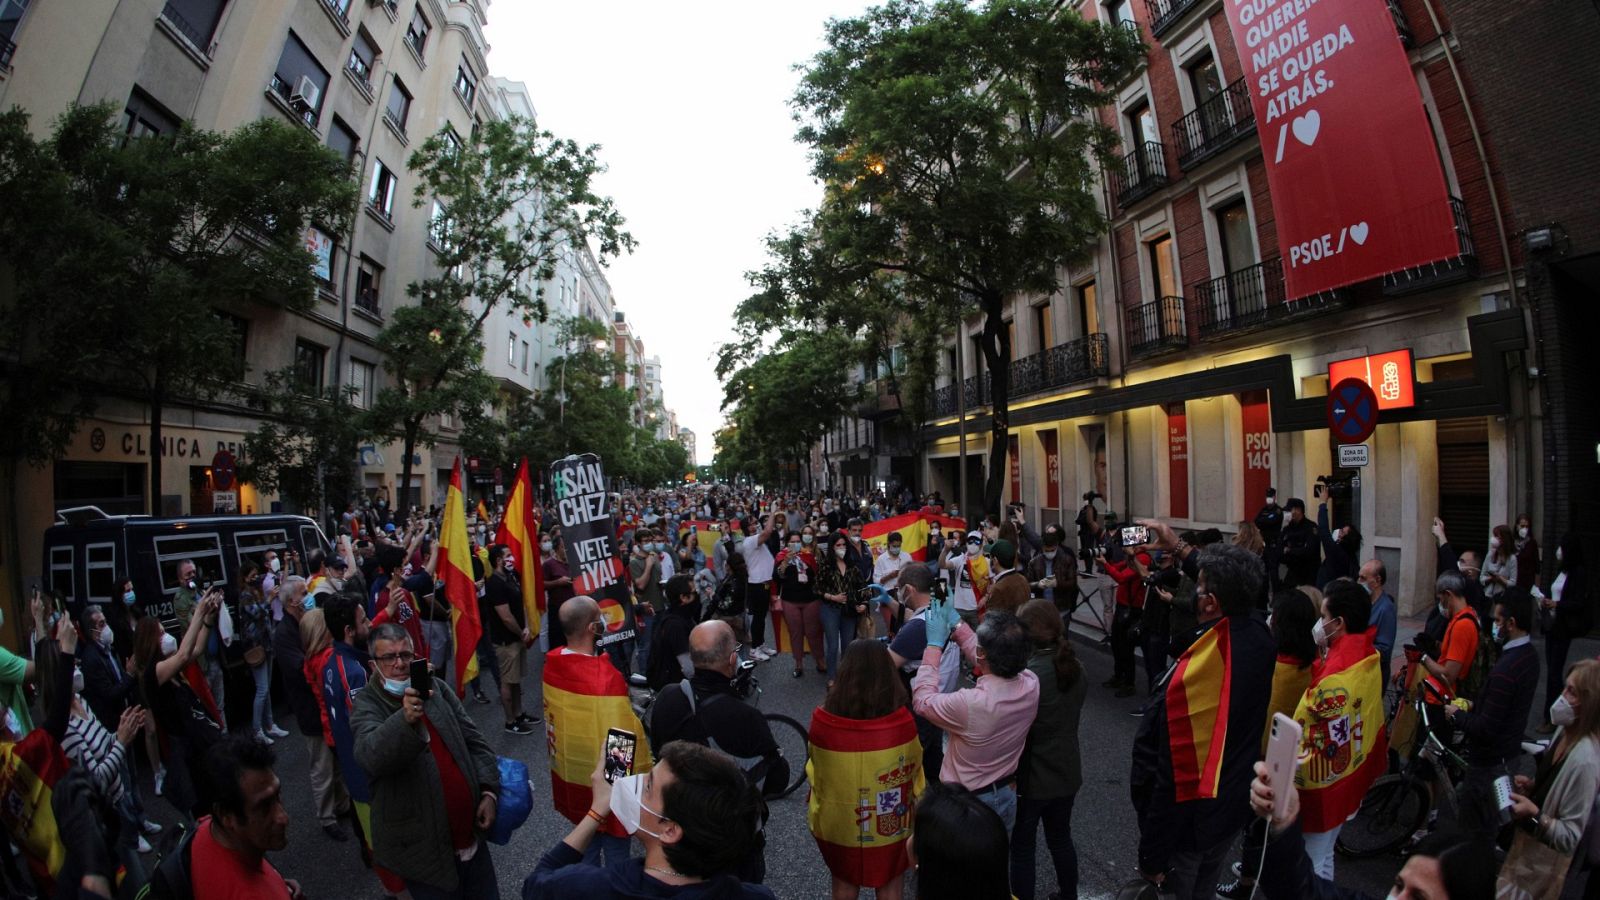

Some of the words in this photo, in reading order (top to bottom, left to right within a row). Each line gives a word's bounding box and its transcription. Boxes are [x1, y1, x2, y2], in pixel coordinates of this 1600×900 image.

[1252, 19, 1310, 73] NADIE
[1258, 67, 1280, 97] SE
[1282, 24, 1355, 81] QUEDA
[1266, 69, 1334, 124] ATRÁS.
[122, 432, 201, 459] CLNICA
[1342, 455, 1367, 463] SEGURIDAD
[554, 462, 605, 500] #SÁN
[559, 491, 610, 528] CHEZ
[573, 535, 613, 563] VETE
[580, 558, 618, 591] ¡YA!
[145, 601, 174, 617] 1U-23
